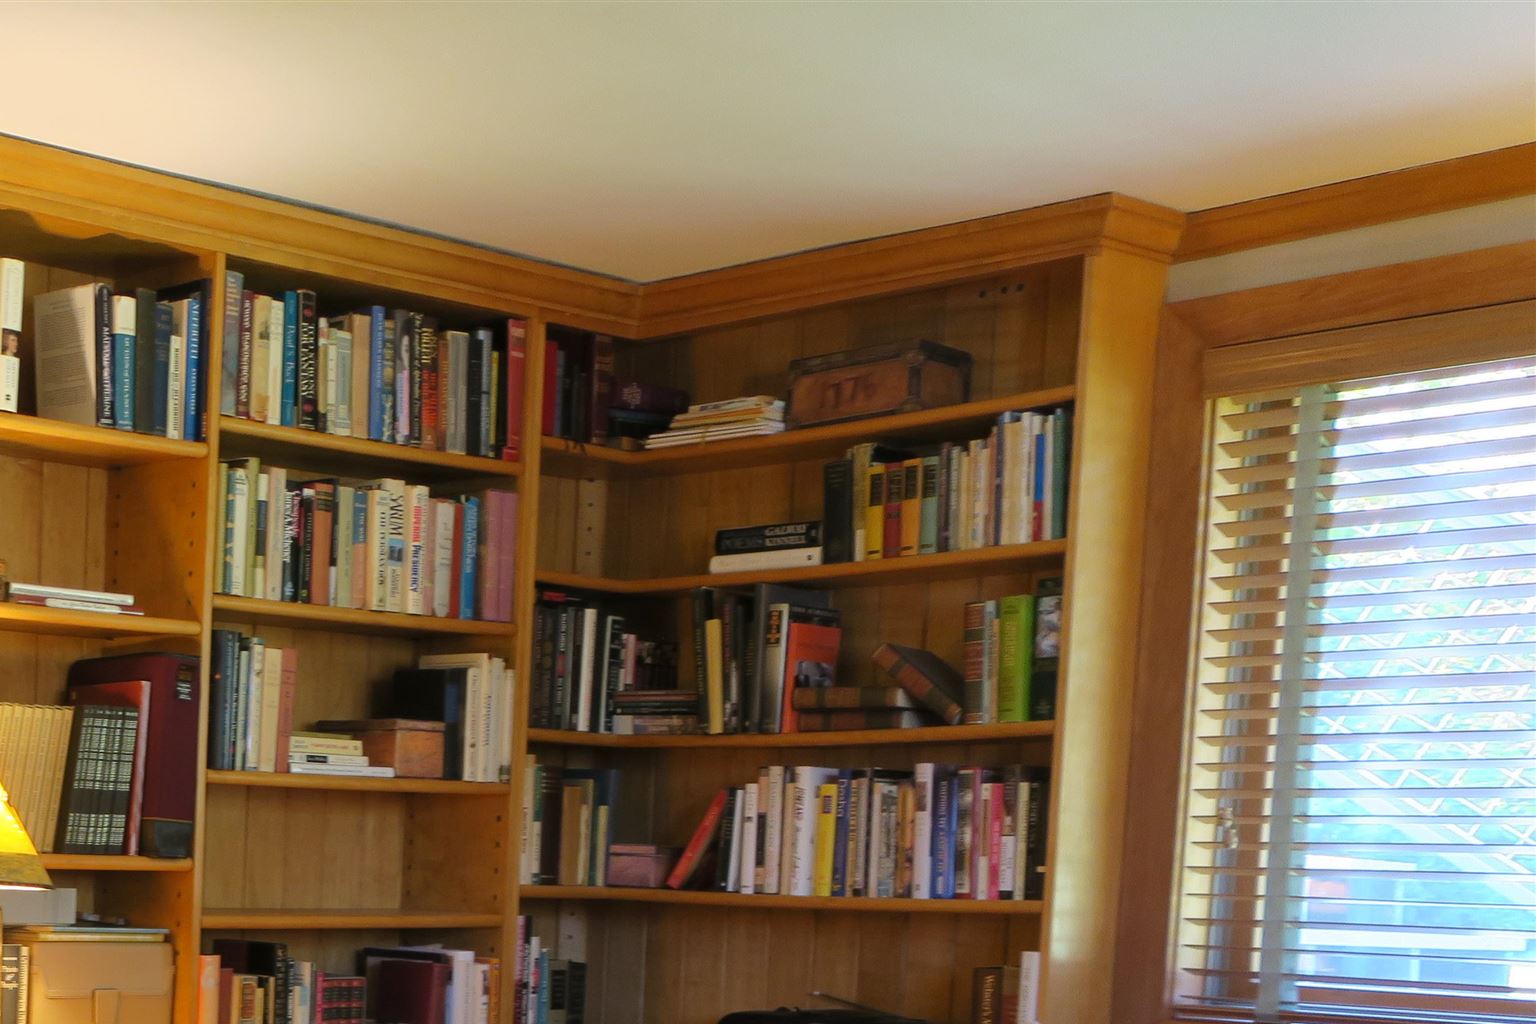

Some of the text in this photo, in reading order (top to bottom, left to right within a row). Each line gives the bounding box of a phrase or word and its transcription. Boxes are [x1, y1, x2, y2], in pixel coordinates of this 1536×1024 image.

[191, 302, 200, 359] NEFERTITI
[285, 361, 294, 383] Buck
[300, 347, 309, 396] FANTASY
[283, 490, 294, 562] James A. Michener
[292, 490, 301, 538] Chesapeake
[389, 495, 404, 536] SARUM
[410, 506, 423, 592] IMPERIAL PRESIDENCY
[982, 975, 996, 1016] Webster's
